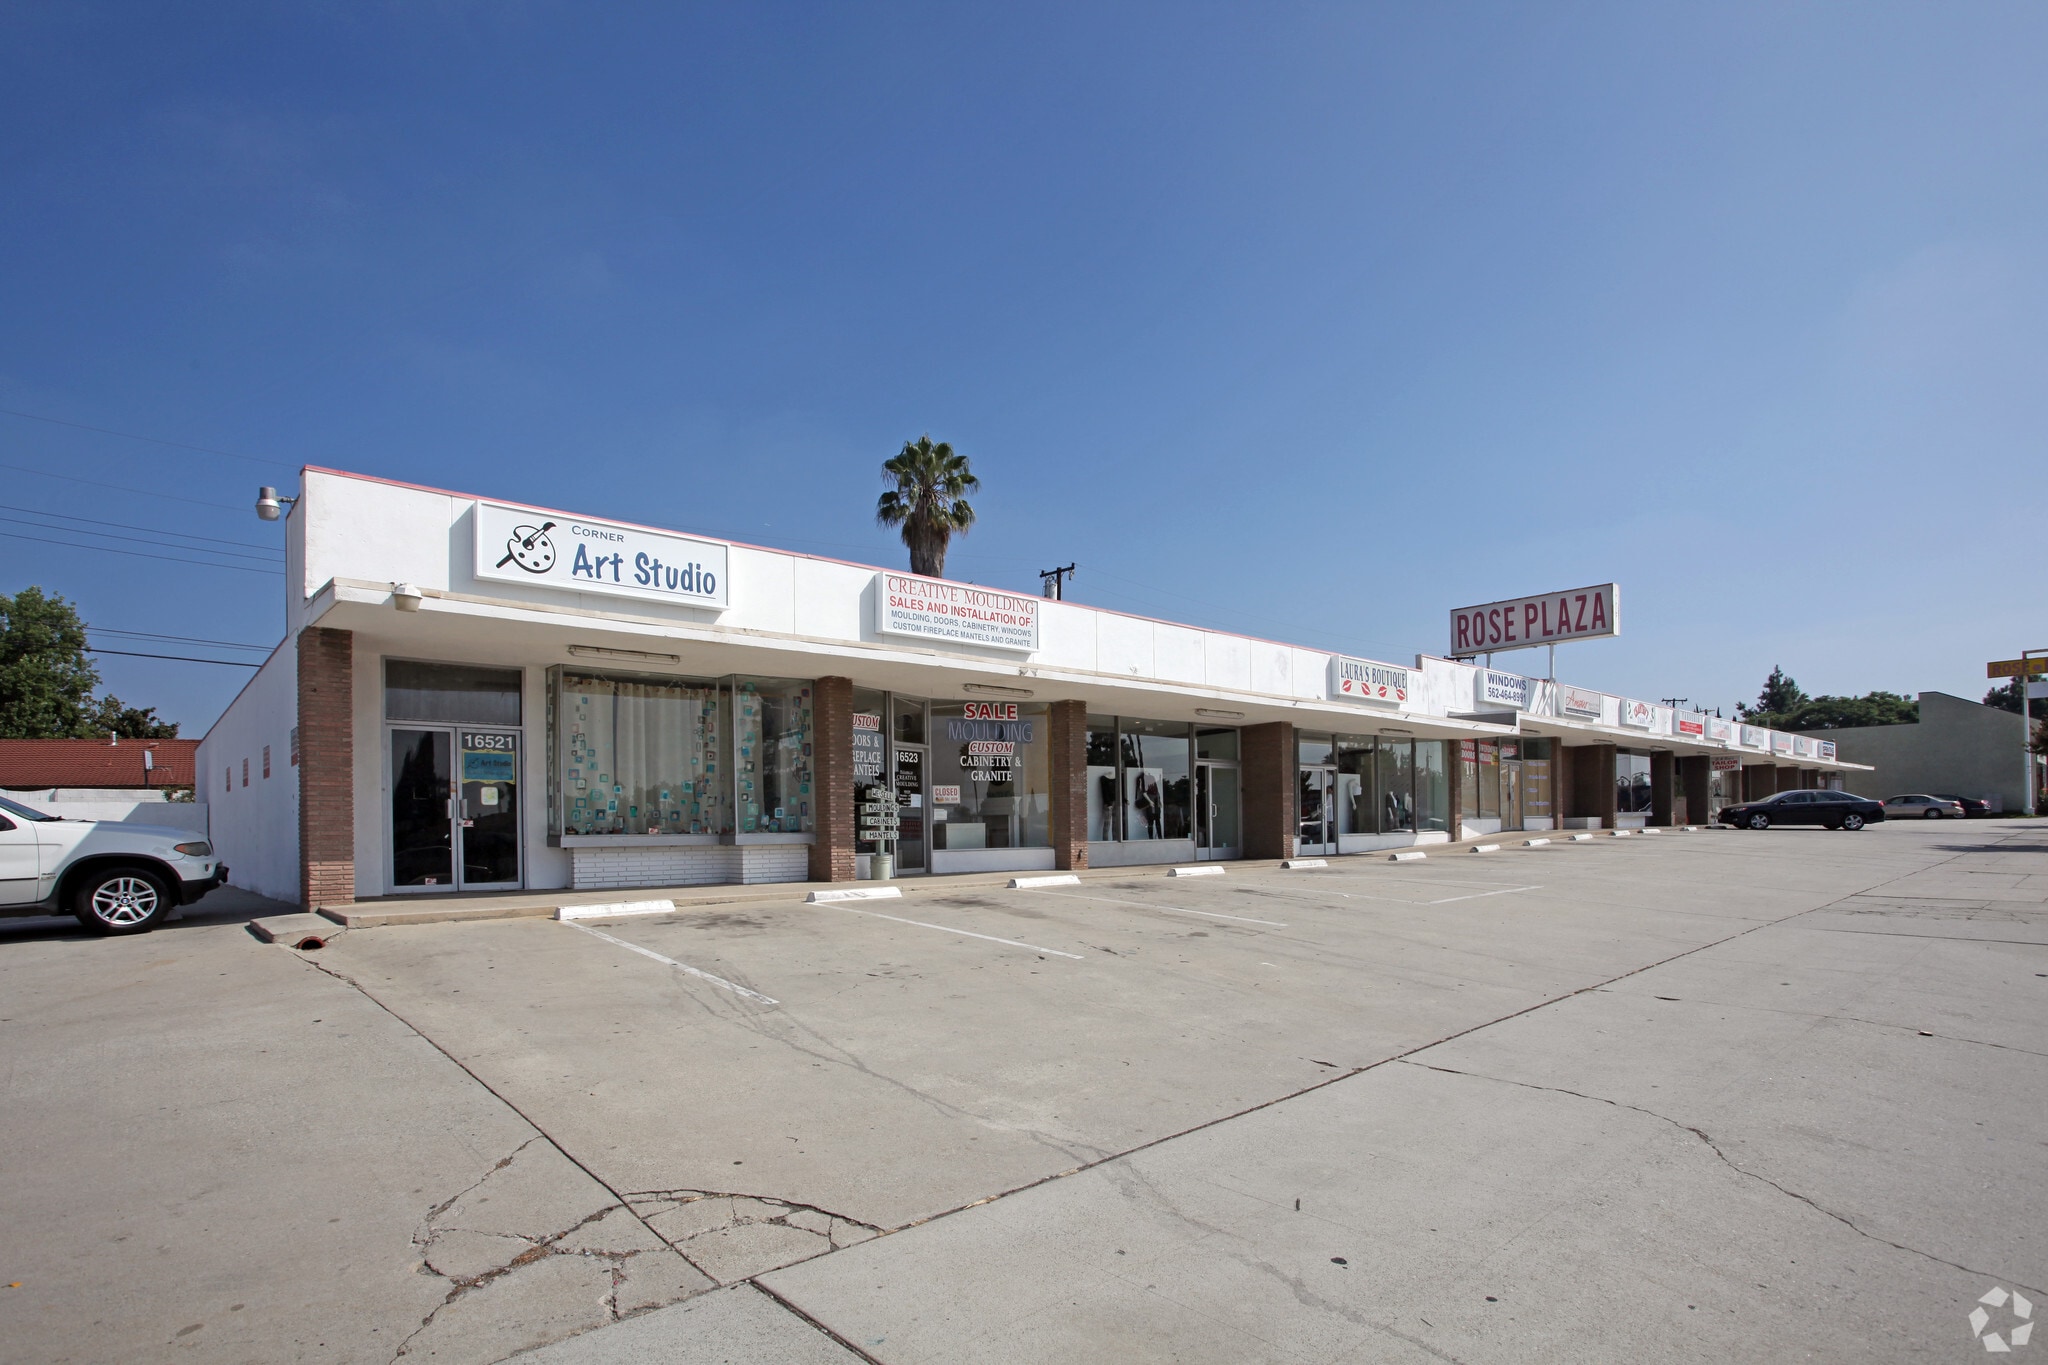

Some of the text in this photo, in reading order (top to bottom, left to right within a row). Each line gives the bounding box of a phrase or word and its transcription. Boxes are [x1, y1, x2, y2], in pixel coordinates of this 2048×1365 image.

[571, 525, 625, 543] CORNER
[572, 543, 717, 596] Art Studio
[888, 576, 1035, 615] CREATIVE MOULDING
[889, 595, 1034, 628] SALES AND INSTALLATION OF:
[891, 610, 1032, 639] MOULDING, DOORS, CABINETRY, WINDOWS
[1457, 591, 1607, 649] ROSE PLAZA
[893, 621, 1031, 648] CUSTOM FIREPLACE MANTELS AND GRANITE
[1341, 661, 1406, 689] LAURA'S BOUTIQUE
[1993, 661, 2029, 676] ROSE
[1487, 673, 1527, 690] WINDOWS
[964, 702, 1018, 720] SALE
[948, 720, 1033, 742] MOULDING
[465, 734, 513, 749] 16521
[873, 736, 879, 748] &
[970, 742, 1014, 755] CUSTOM
[895, 751, 919, 764] 16523
[960, 755, 1022, 768] CABINETRY &
[971, 770, 1013, 781] GRANITE
[934, 787, 958, 796] CLOSED
[868, 803, 899, 812] MOULDINGS
[869, 817, 898, 826] CABINETS
[869, 831, 898, 840] MANTELS
